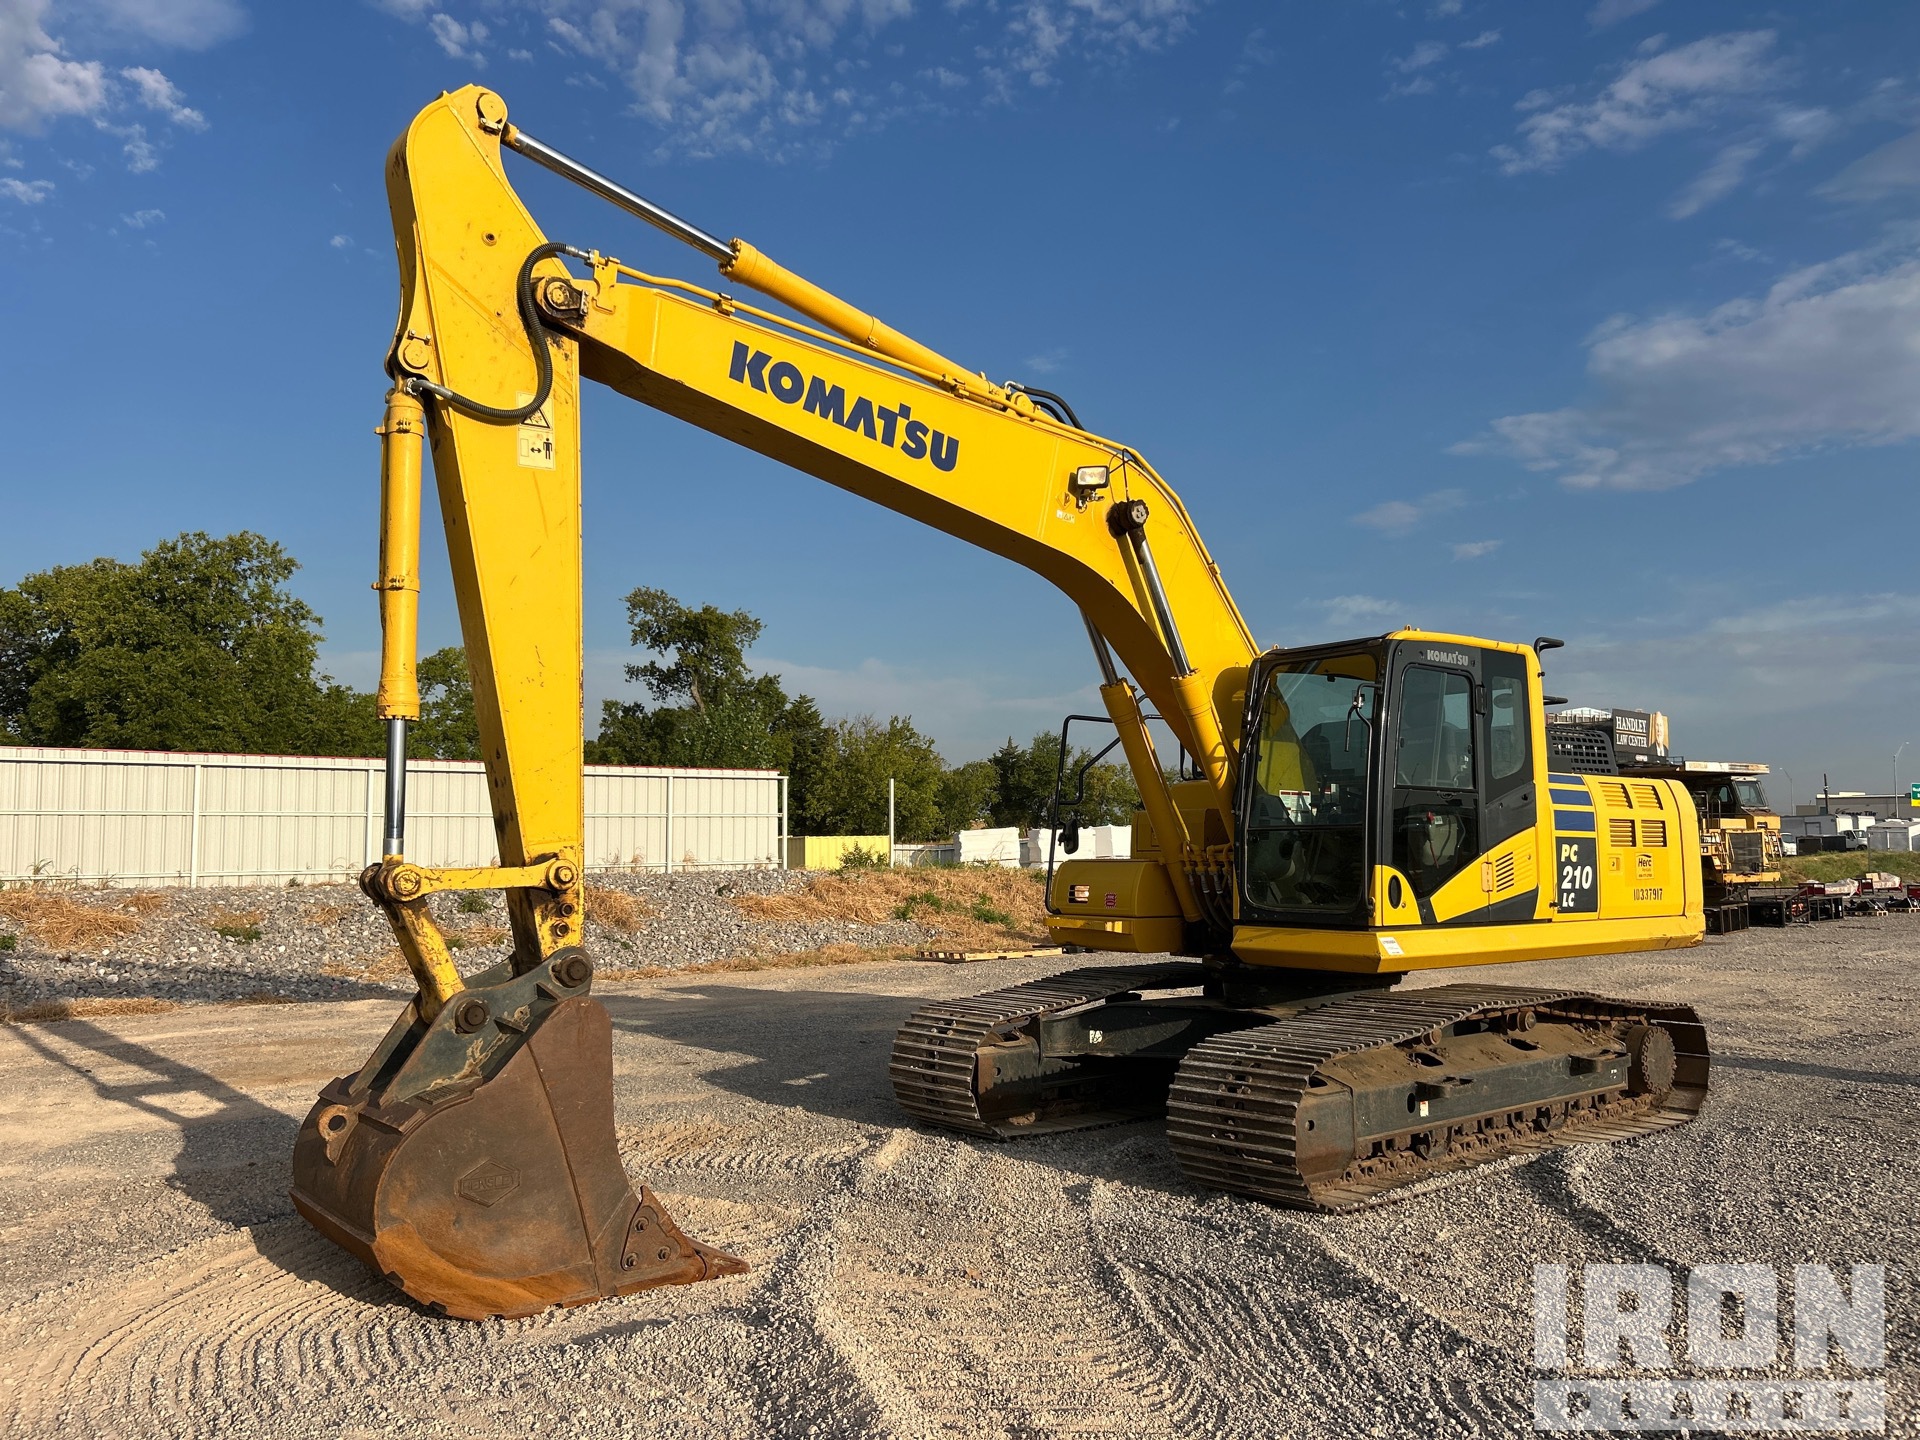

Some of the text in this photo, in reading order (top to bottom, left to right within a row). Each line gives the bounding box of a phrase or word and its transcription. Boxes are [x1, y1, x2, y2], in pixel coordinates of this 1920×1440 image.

[729, 340, 959, 472] KOMATSU
[1427, 650, 1469, 666] KOMATSU
[1616, 716, 1647, 733] HANDLEY
[1616, 734, 1648, 748] LAW CENTER
[1561, 844, 1578, 862] PC
[1638, 858, 1652, 867] Herc
[1561, 865, 1593, 889] 210
[1562, 892, 1575, 907] LC
